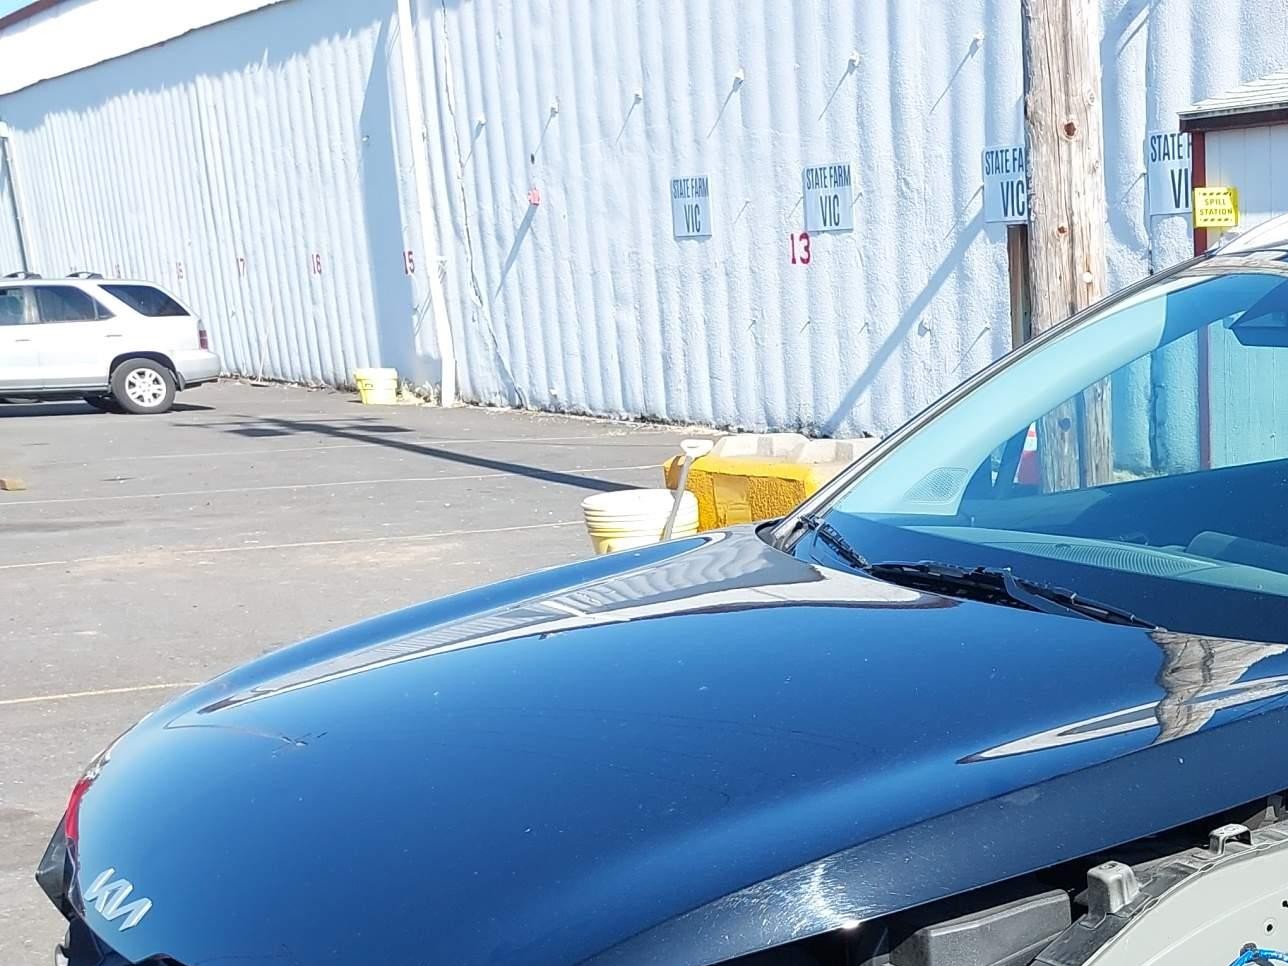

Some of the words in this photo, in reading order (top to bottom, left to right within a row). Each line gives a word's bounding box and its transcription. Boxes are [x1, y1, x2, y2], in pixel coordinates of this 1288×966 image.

[985, 148, 1011, 176] STATE
[1012, 147, 1025, 173] FA
[1150, 133, 1184, 163] STATE
[673, 178, 690, 199] STATE
[691, 177, 710, 198] FARM
[806, 166, 828, 190] STATE
[829, 164, 852, 187] FARM
[1170, 167, 1190, 209] VI
[820, 194, 841, 227] VIC
[1000, 180, 1026, 217] VIC
[1199, 208, 1233, 216] STATION
[1204, 198, 1226, 206] SPILL
[684, 203, 702, 233] VIC
[789, 232, 812, 265] 13
